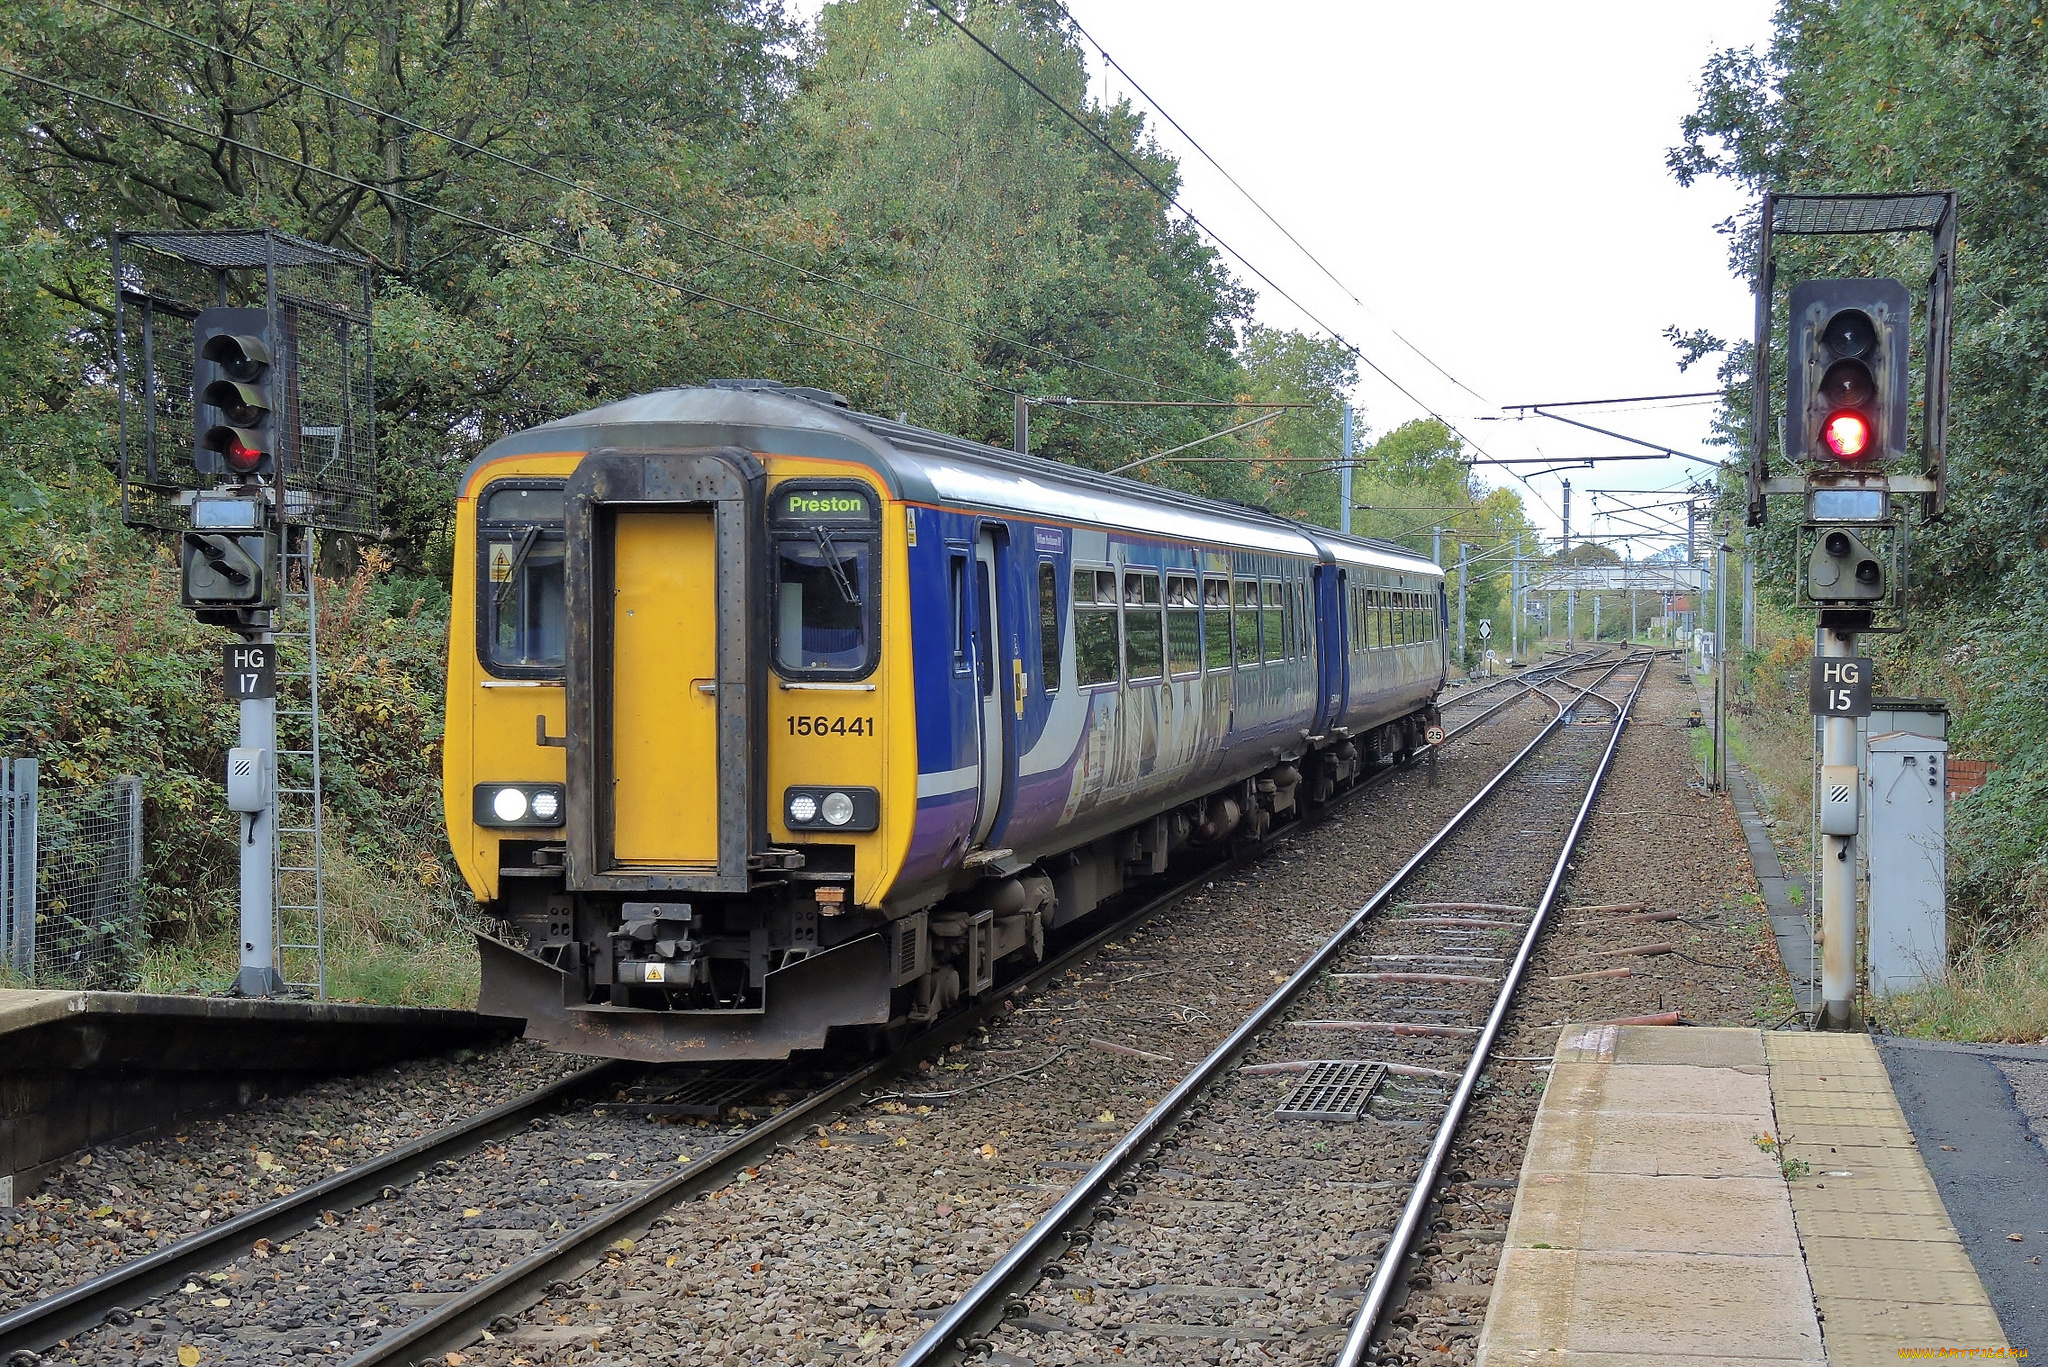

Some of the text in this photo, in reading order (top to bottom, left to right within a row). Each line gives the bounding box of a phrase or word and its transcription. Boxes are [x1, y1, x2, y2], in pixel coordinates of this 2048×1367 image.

[789, 496, 861, 512] Preston
[234, 649, 265, 668] HG
[240, 673, 259, 693] 17
[1823, 662, 1859, 684] HG
[1829, 689, 1852, 711] 15
[787, 715, 874, 737] 156441
[1428, 731, 1442, 740] 25
